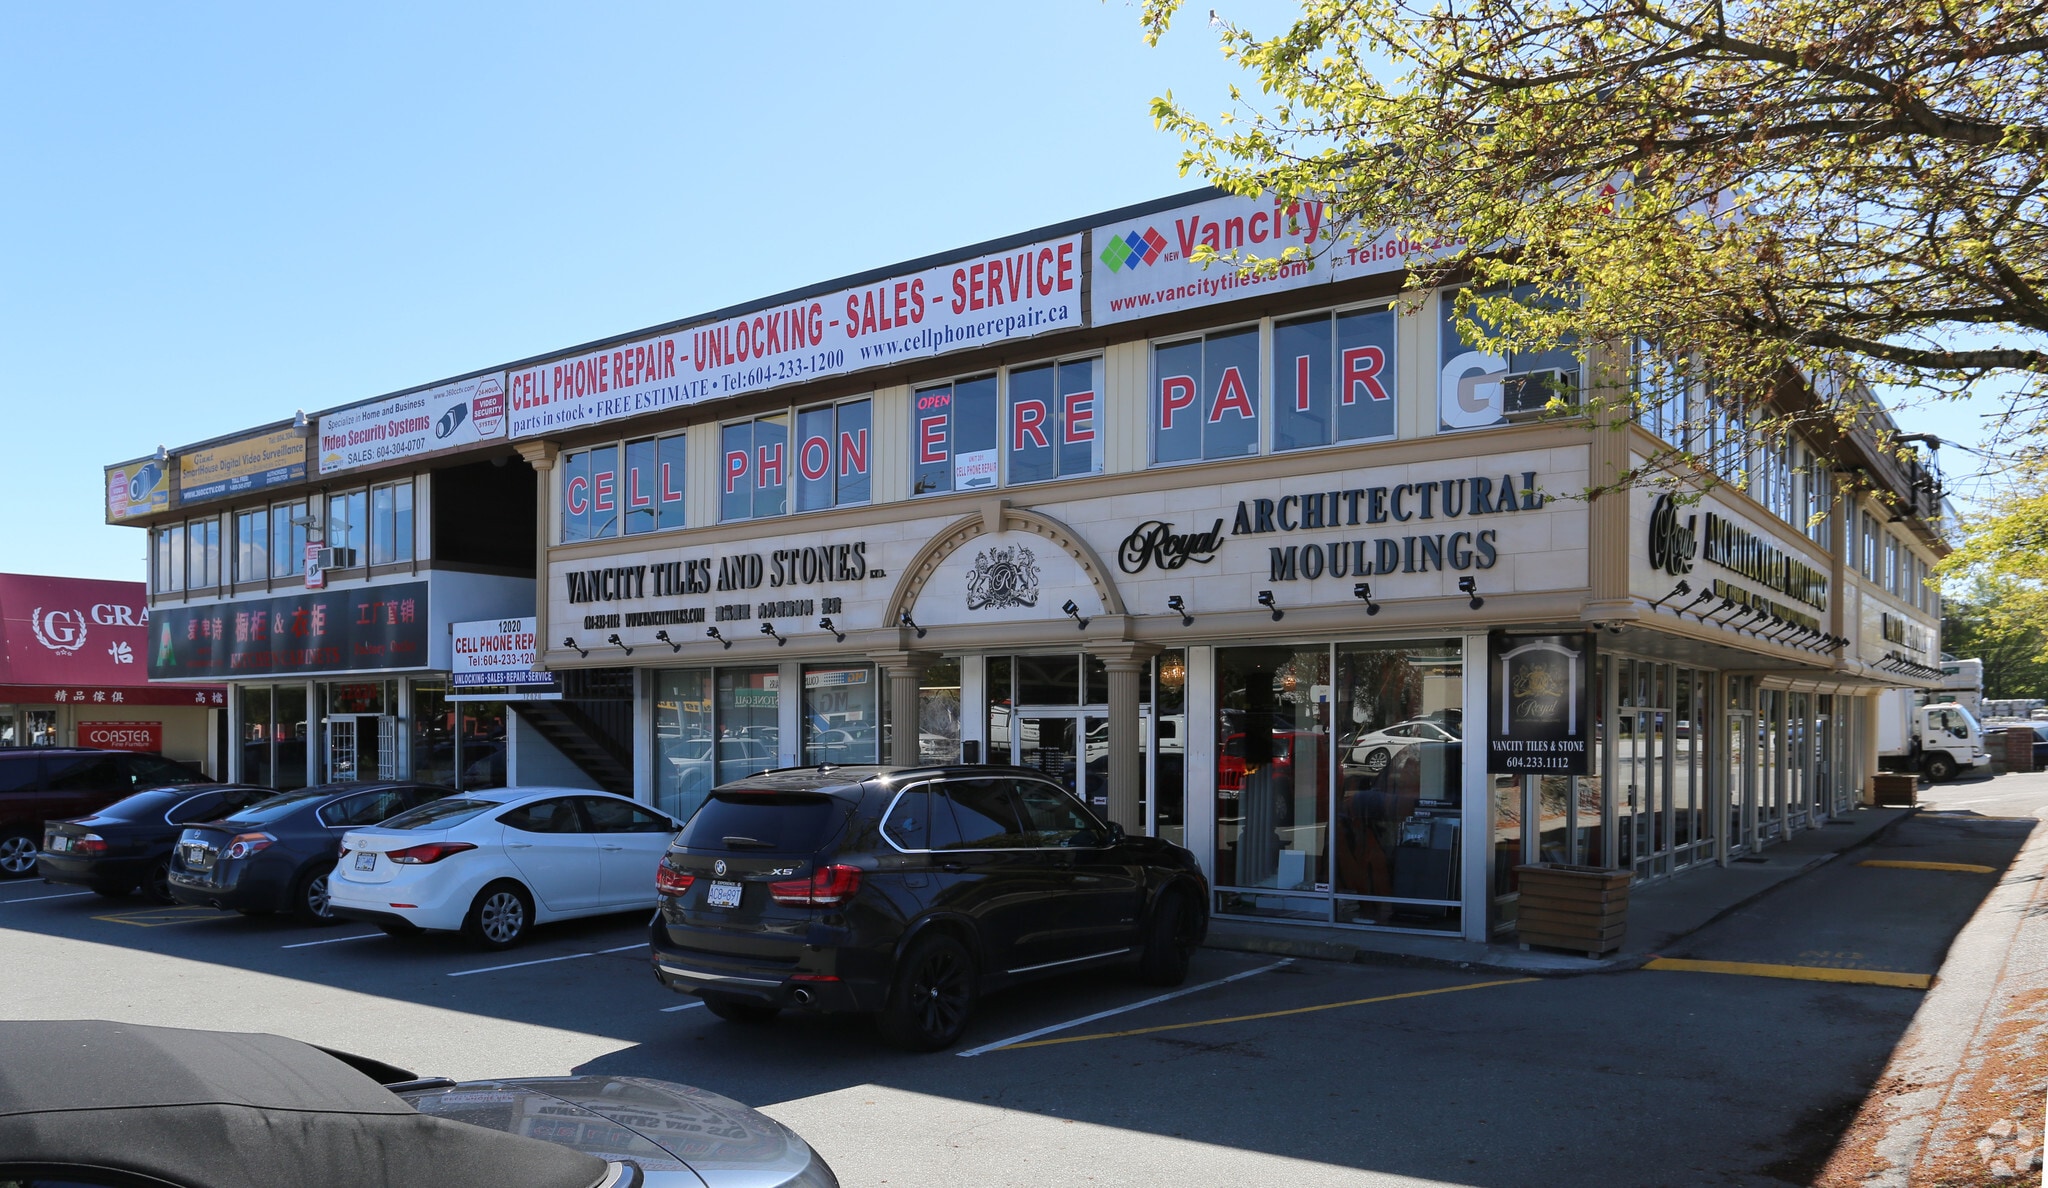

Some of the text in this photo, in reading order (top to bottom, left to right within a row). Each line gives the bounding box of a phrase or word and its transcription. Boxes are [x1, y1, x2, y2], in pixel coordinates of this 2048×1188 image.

[1164, 198, 1323, 262] NEW Vancity
[513, 369, 549, 411] CELL
[553, 355, 608, 402] PHONE
[612, 339, 675, 396] REPAIR
[693, 303, 823, 372] UNLOCKING
[846, 278, 925, 339] SALES
[951, 242, 1073, 315] SERVICE
[513, 304, 1069, 436] parts in stock FREE ESTIMATE Tel:604-233-1200 www.cellphonerepair.ca
[433, 385, 475, 400] www.360cctv.com
[478, 386, 498, 396] 24-HOUR
[917, 393, 951, 410] OPEN
[1441, 350, 1507, 429] G
[474, 405, 502, 418] SECURITY
[479, 397, 497, 407] VIDEO
[328, 416, 354, 431] Specialize
[362, 410, 380, 420] Home
[382, 404, 393, 416] and
[395, 399, 425, 412] Business
[322, 415, 430, 452] Video Security Systems
[183, 463, 219, 479] SmartHouse
[220, 456, 240, 472] Digital
[243, 453, 261, 465] Video
[263, 444, 304, 460] Surveillance
[348, 449, 375, 464] SALES:
[377, 438, 425, 457] 604-304-0707
[956, 462, 997, 478] CELL PHONE REPAIR
[1230, 471, 1544, 535] ARCHITECTURAL
[1117, 518, 1224, 575] Royal
[1649, 493, 1698, 576] Royal
[1268, 529, 1497, 583] MOULDINGS
[566, 565, 646, 604] VANCITY
[650, 557, 711, 597] TILES
[716, 553, 763, 591] AND
[771, 542, 866, 587] STONES
[44, 611, 75, 642] G
[274, 612, 285, 634] &
[291, 604, 327, 637] 衣柜
[498, 620, 521, 633] 12020
[108, 641, 134, 664] 怡
[455, 637, 478, 653] CELL
[480, 635, 512, 652] PHONE
[230, 651, 279, 669] KITCHEN
[280, 647, 341, 666] CABINETS
[1516, 699, 1558, 718] Royal
[90, 730, 150, 743] COASTER
[1492, 740, 1585, 752] VANCITY TILES & STONE
[1506, 757, 1569, 768] 604.233.1112
[770, 868, 793, 876] X5
